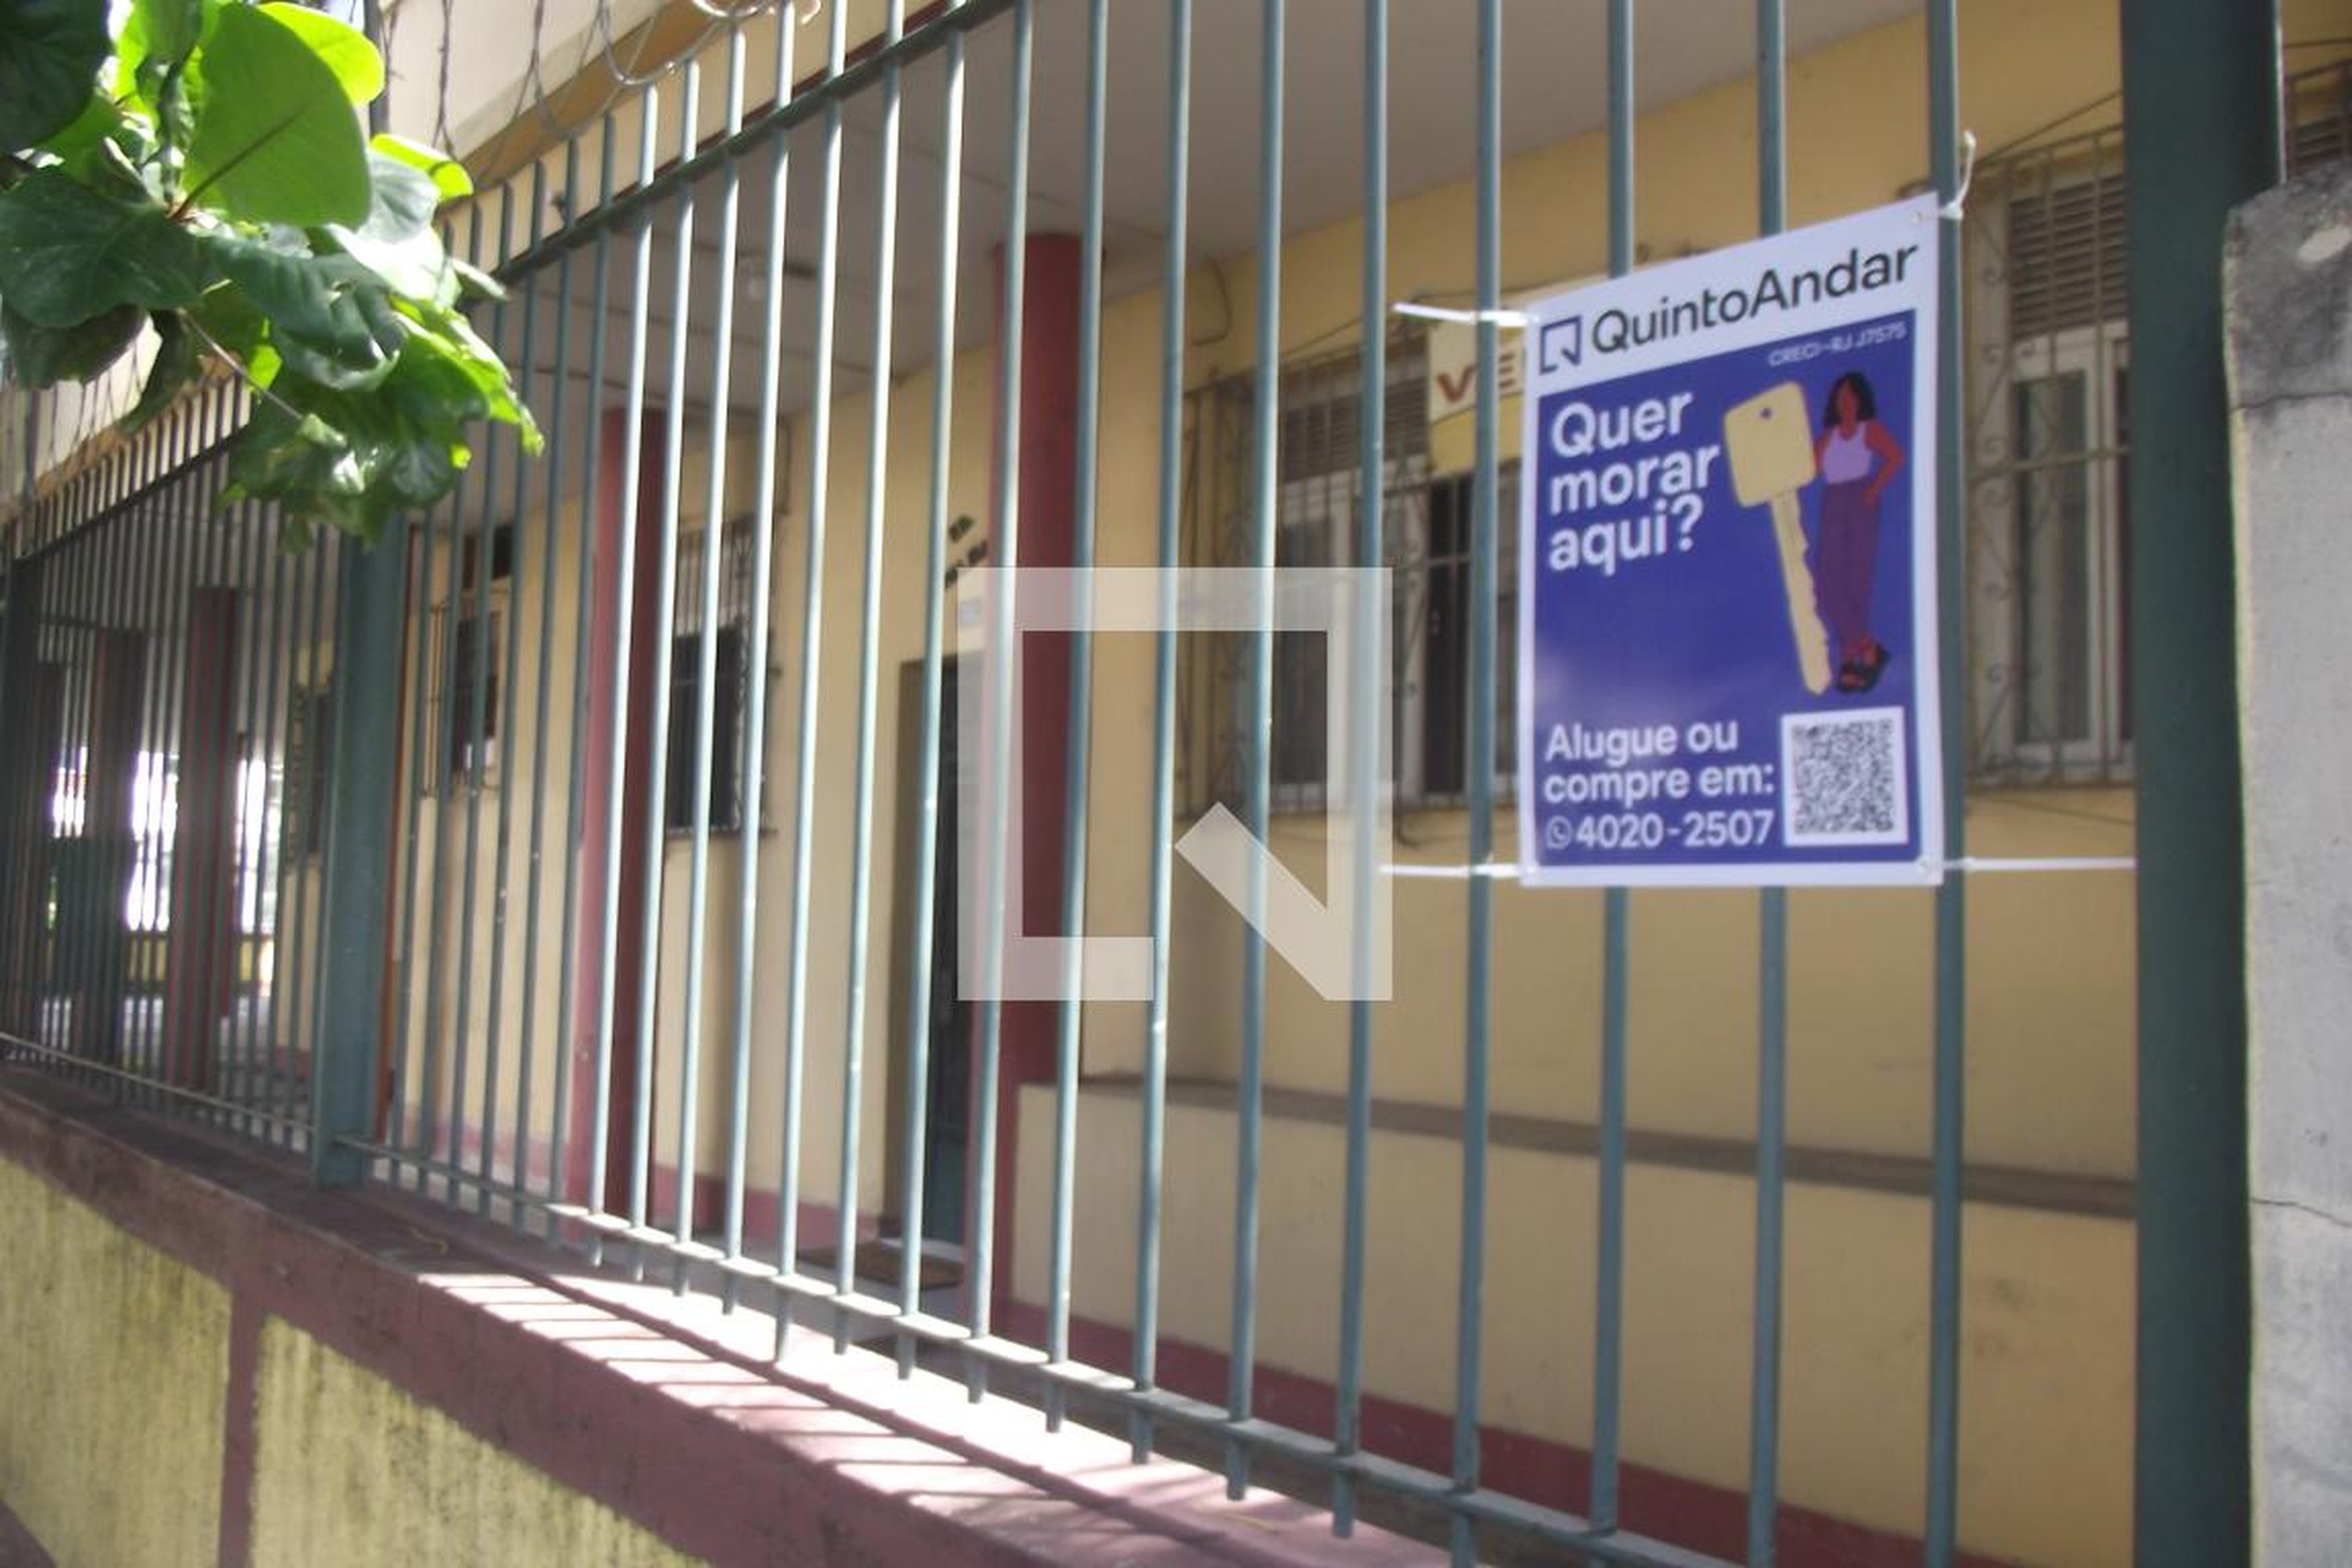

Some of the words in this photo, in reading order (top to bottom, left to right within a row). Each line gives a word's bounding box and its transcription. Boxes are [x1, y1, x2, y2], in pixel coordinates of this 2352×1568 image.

[1592, 245, 1918, 354] QuintoAndar
[1551, 393, 1693, 458] Quer
[1550, 445, 1721, 516] morar
[1549, 493, 1703, 577] aqui?
[1544, 722, 1678, 768] Alugue
[1687, 720, 1739, 753] ou
[1543, 767, 1691, 809] compre
[1698, 763, 1775, 795] em:
[1575, 809, 1774, 849] 4020-2507
